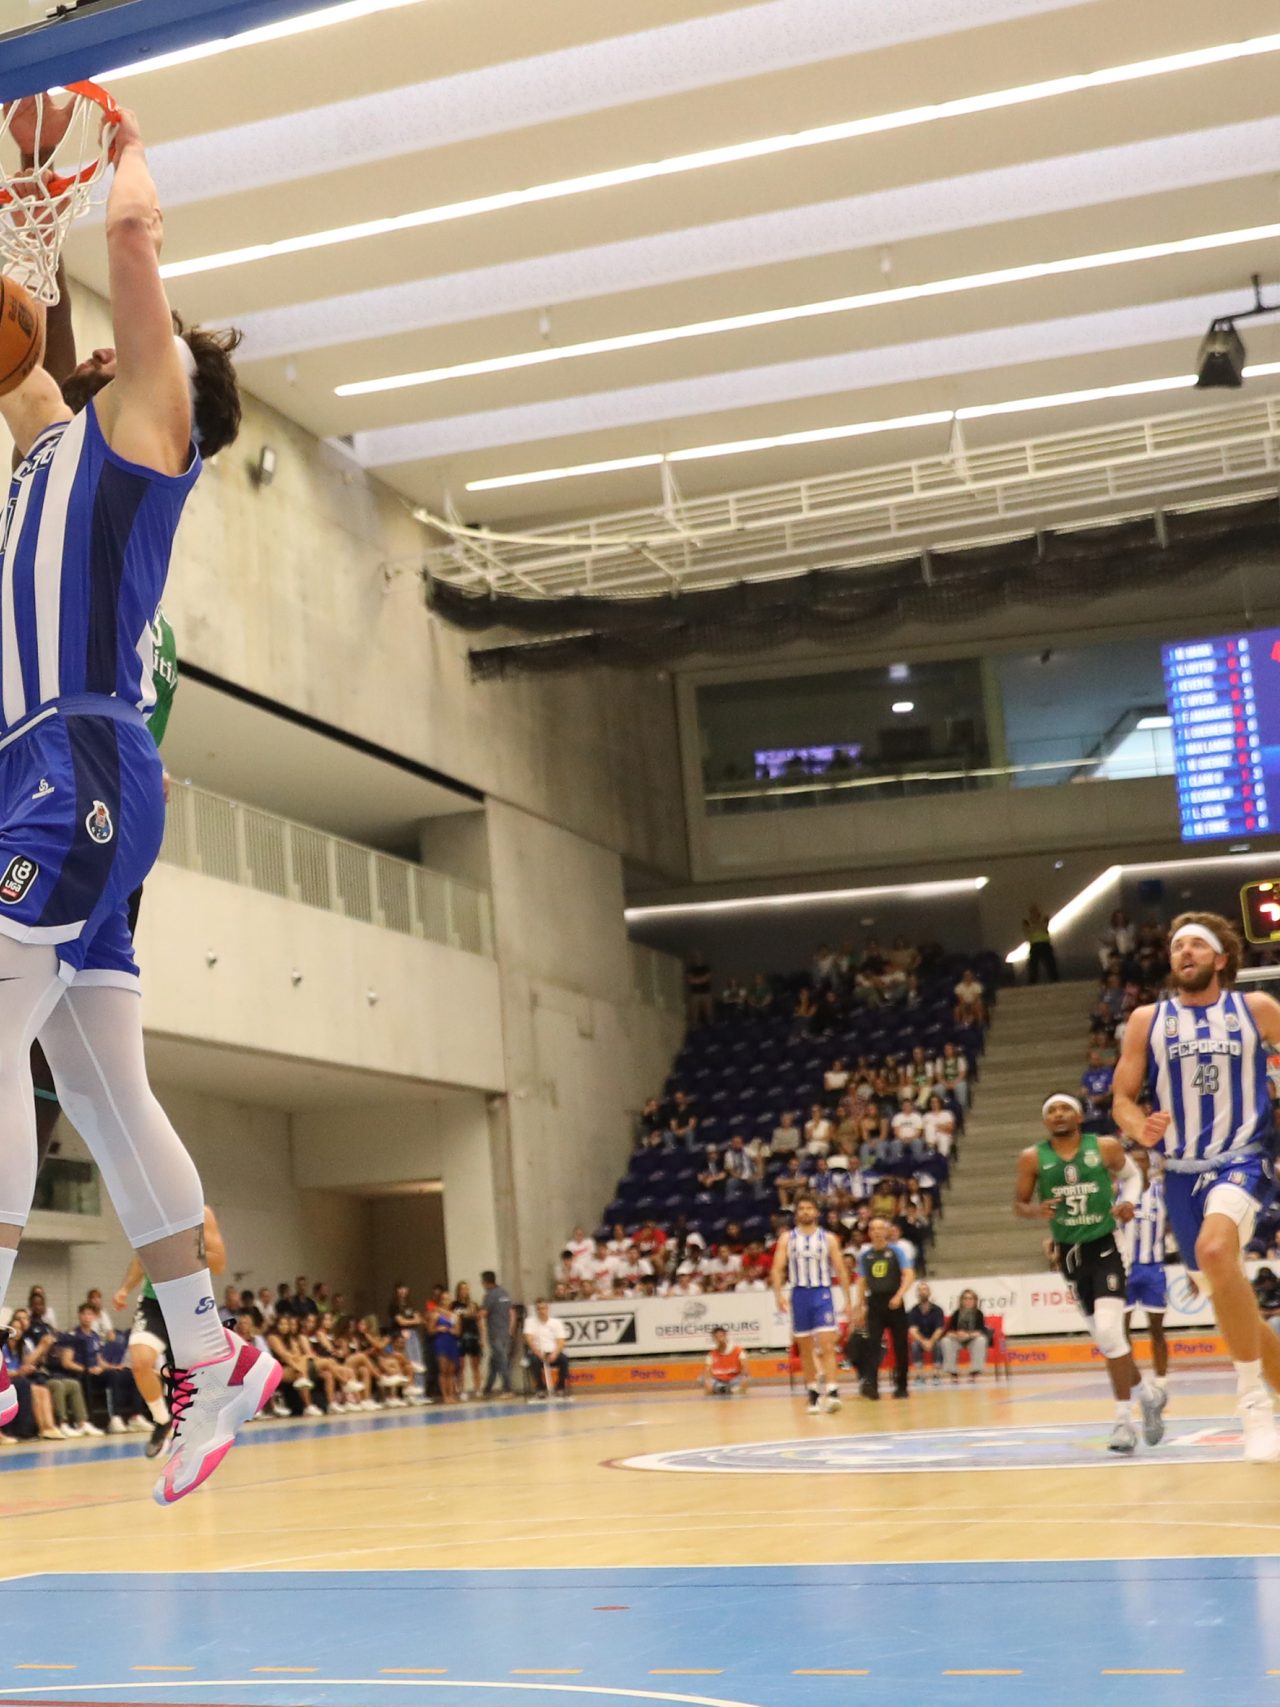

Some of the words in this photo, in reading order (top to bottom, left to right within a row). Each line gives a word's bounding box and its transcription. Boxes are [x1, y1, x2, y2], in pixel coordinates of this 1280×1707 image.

[1191, 1064, 1220, 1096] 43
[1051, 1181, 1099, 1198] SPORTING
[1065, 1195, 1088, 1216] 57
